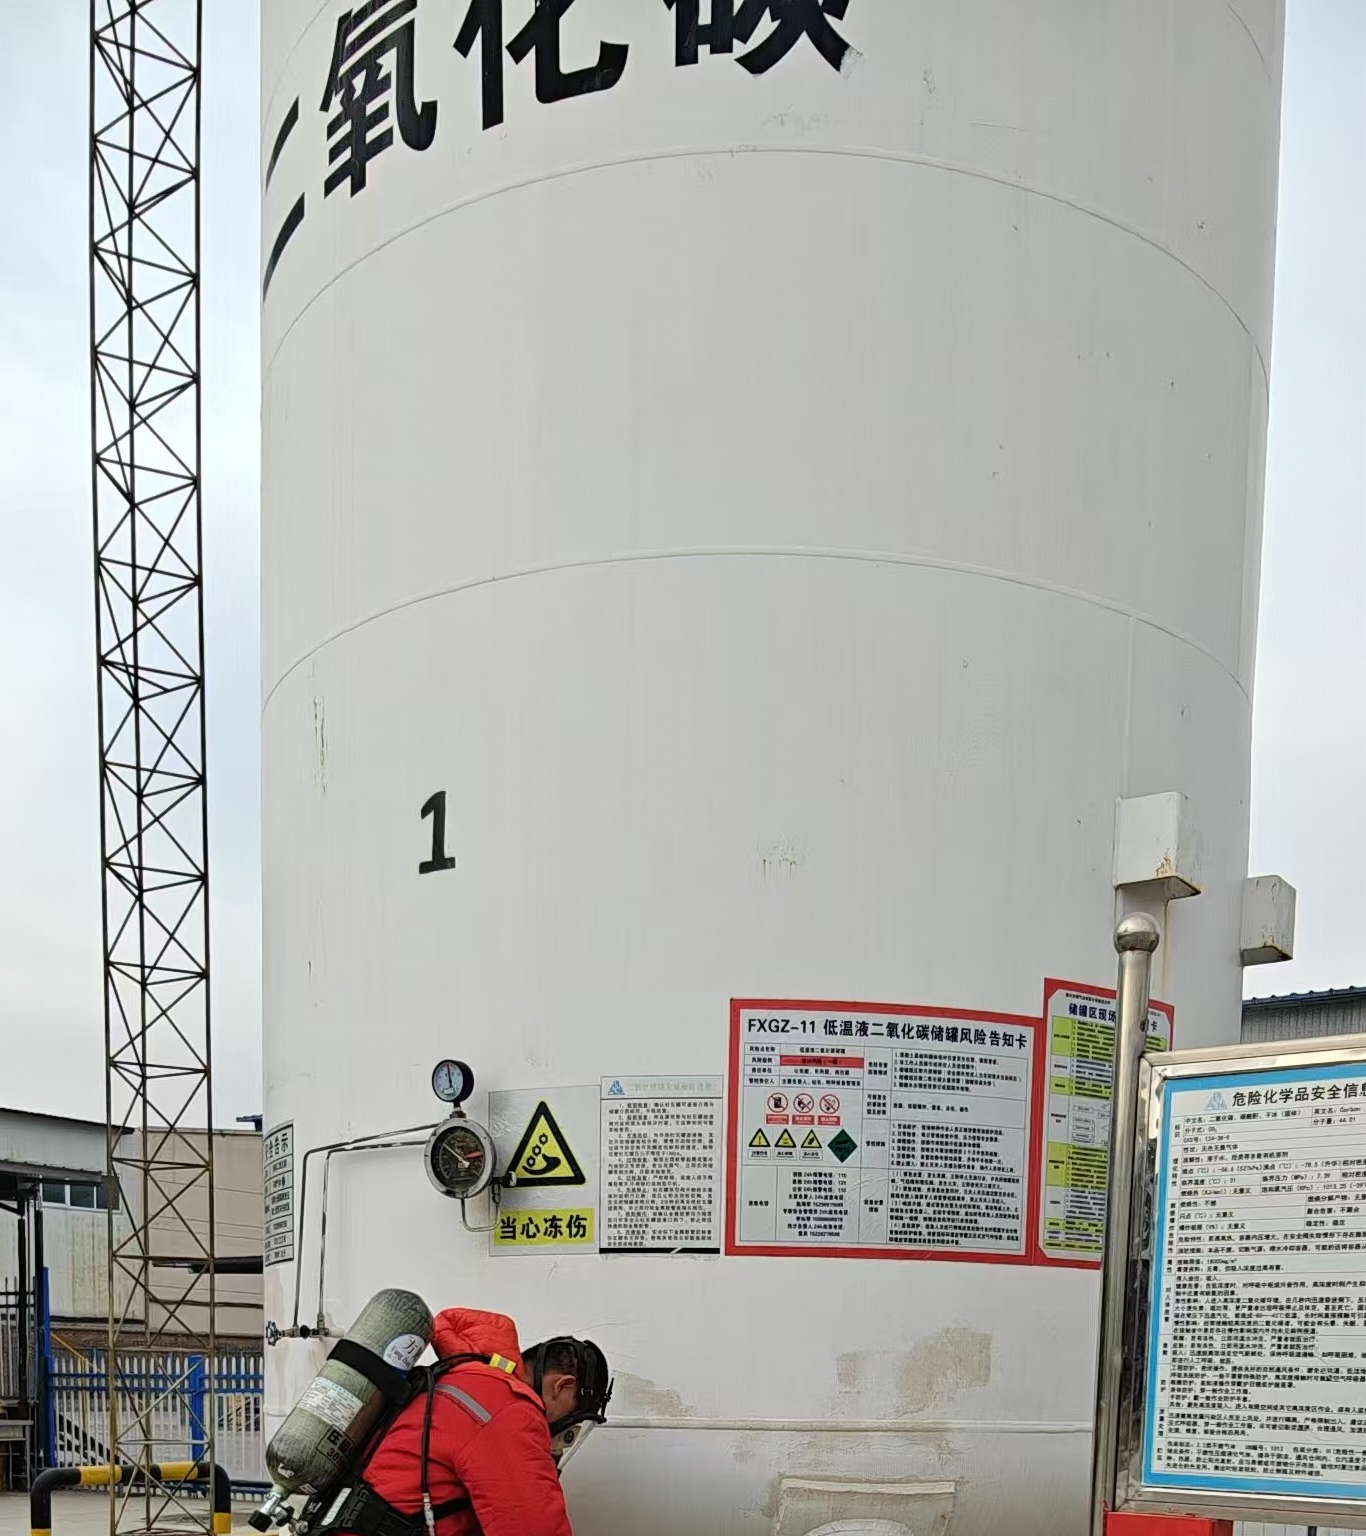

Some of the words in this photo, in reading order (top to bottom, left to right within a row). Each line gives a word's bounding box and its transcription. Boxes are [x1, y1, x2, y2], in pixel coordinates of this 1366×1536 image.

[418, 789, 457, 874] 1
[747, 1018, 816, 1035] FXGZ-11
[823, 1020, 1028, 1050] 低温液二氧化碳储罐风险告知卡
[499, 1215, 588, 1240] 当心冻伤
